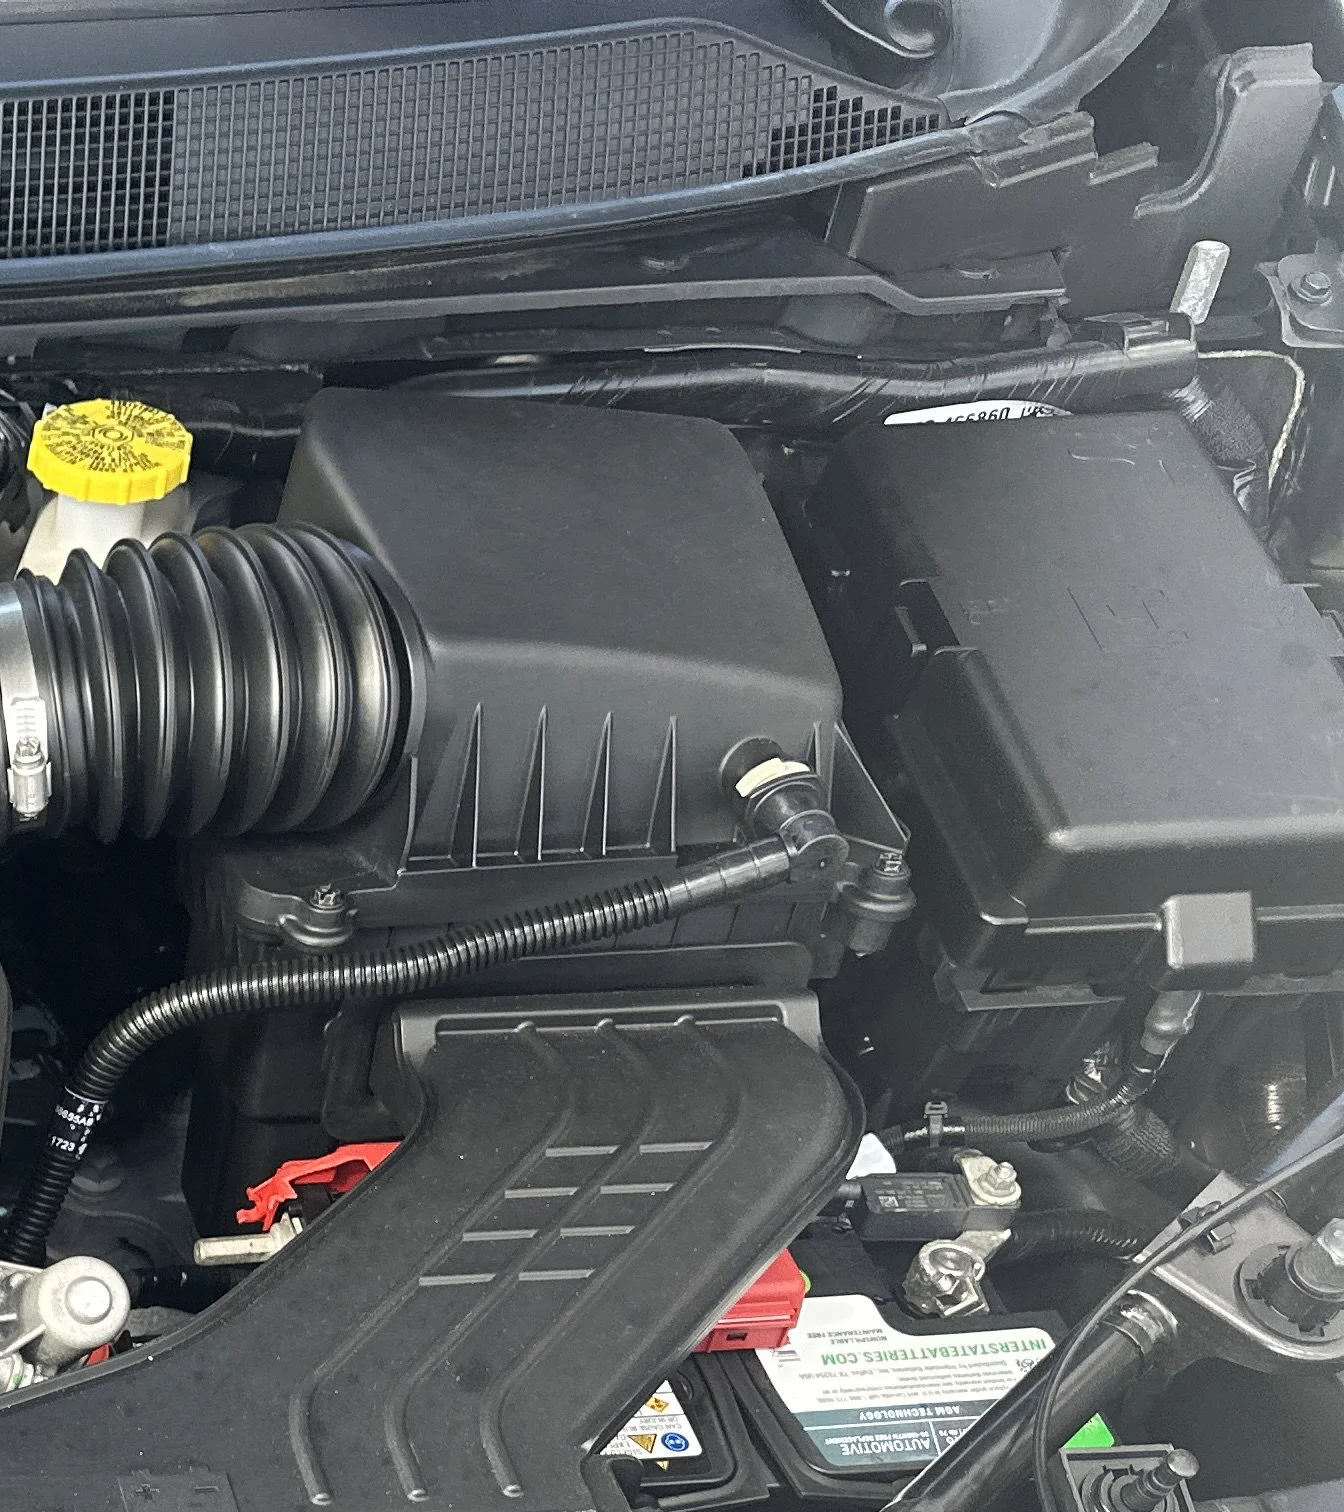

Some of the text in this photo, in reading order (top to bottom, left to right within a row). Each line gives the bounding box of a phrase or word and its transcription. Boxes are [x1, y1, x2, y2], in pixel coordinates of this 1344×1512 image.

[820, 1338, 1047, 1366] INTERSTATEBATTERIES.COM
[859, 1405, 960, 1421] AGM TECHNOLOGY
[840, 1437, 931, 1456] AUTOMOTIVE
